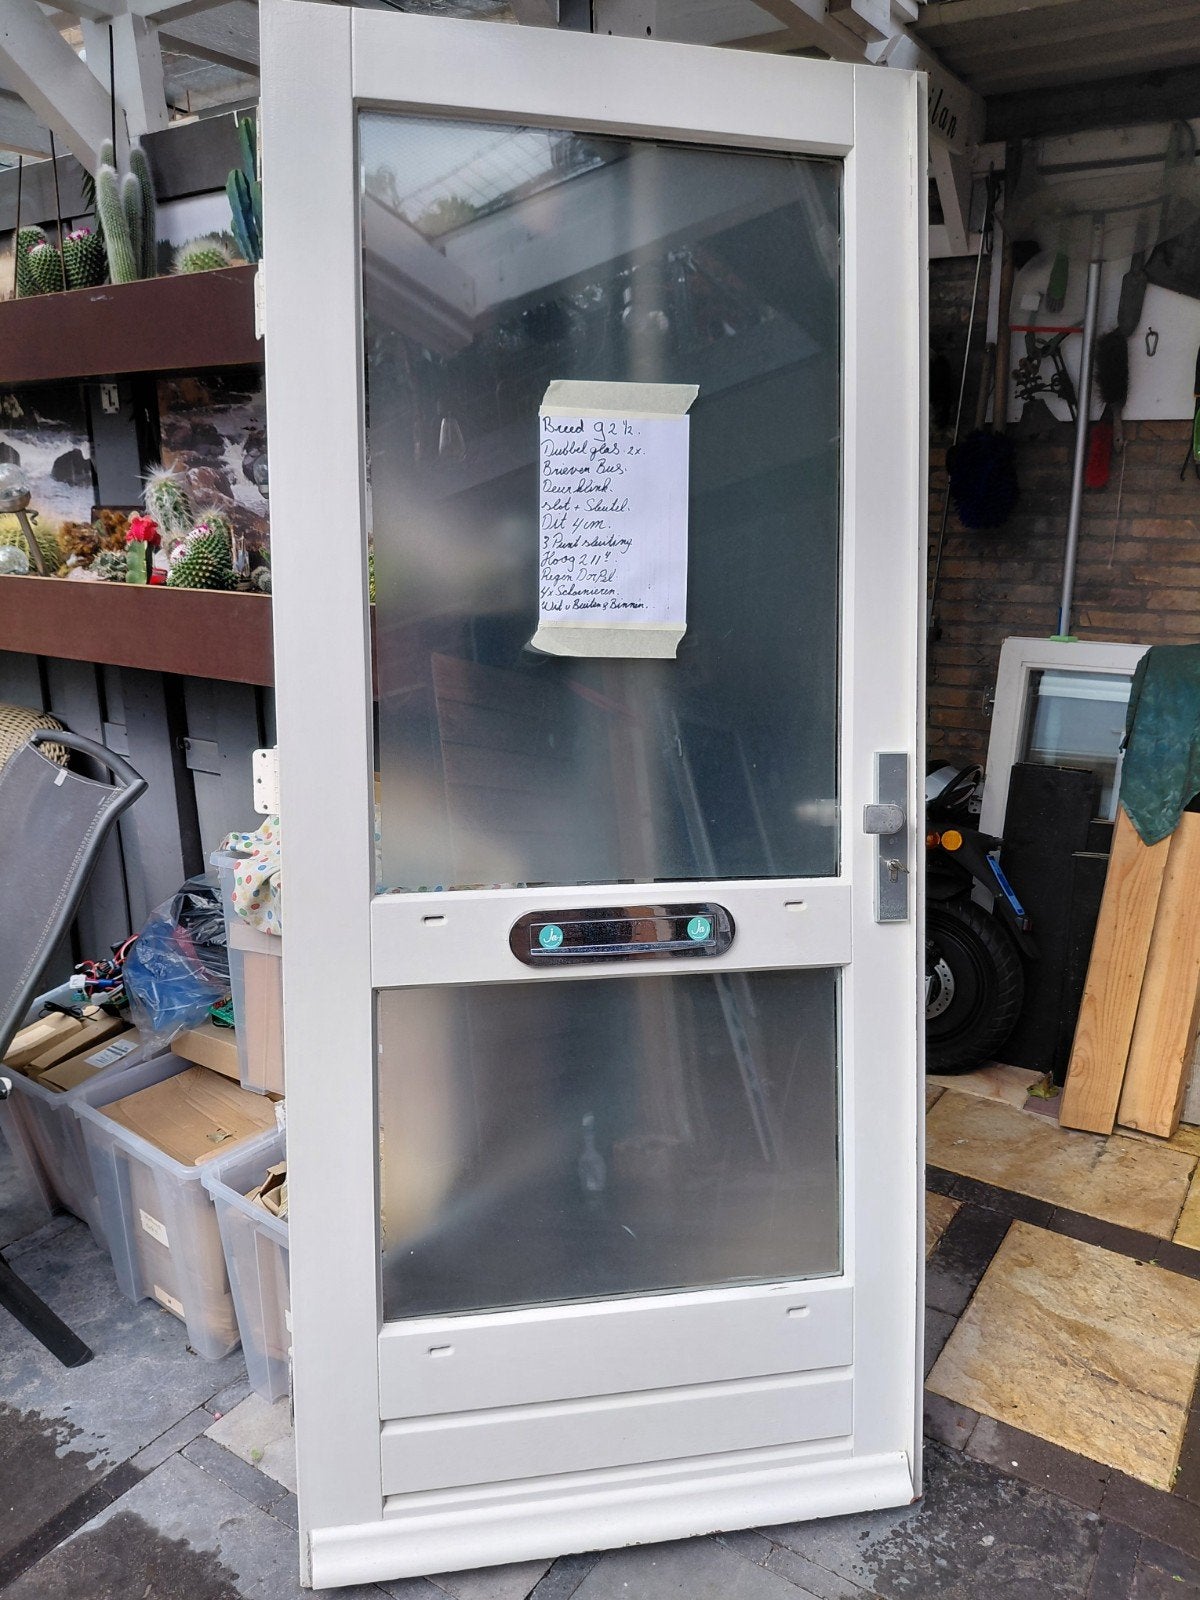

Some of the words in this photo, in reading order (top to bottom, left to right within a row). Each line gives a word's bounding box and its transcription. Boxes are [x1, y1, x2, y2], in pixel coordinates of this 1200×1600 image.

[543, 416, 584, 433] Breed
[541, 439, 587, 457] Dubbel
[543, 460, 590, 476] Brieven
[543, 536, 549, 549] 3
[541, 551, 575, 572] Hoog
[541, 567, 573, 586] Regen
